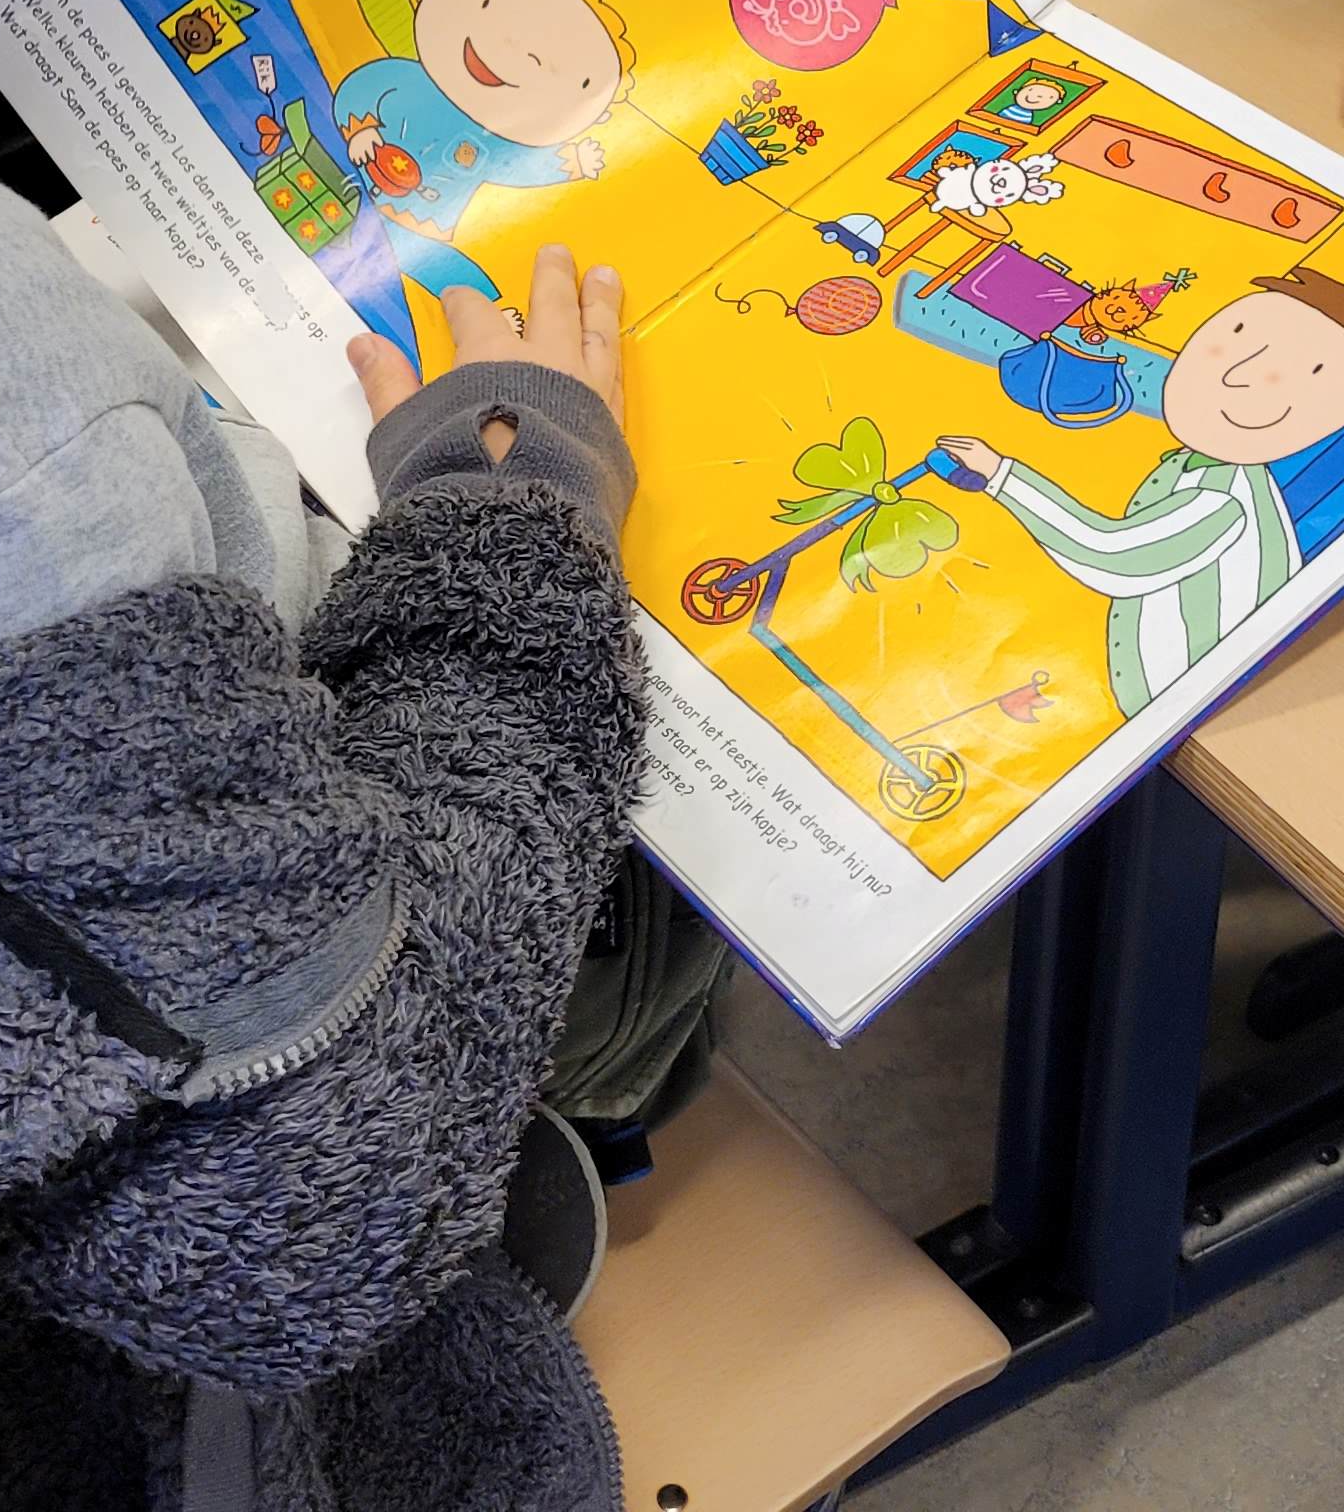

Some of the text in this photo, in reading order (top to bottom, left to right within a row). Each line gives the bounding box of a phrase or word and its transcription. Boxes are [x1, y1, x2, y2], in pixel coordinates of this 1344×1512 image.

[67, 8, 84, 28] de
[77, 26, 110, 61] poes
[106, 62, 125, 77] al
[114, 77, 177, 144] gevonden?
[0, 3, 205, 269] Wat draagt Sam de poes op haar kopje?
[55, 34, 97, 90] kleuren
[94, 86, 136, 142] hebben
[134, 141, 151, 161] de
[149, 160, 178, 196] twee
[175, 195, 222, 251] wieltjes
[219, 250, 240, 277] van
[238, 277, 256, 296] de
[171, 144, 195, 173] Los
[192, 174, 215, 201] dan
[211, 200, 241, 229] snel
[235, 230, 264, 264] deze
[307, 321, 328, 342] op:
[638, 748, 695, 797] rootste?
[660, 727, 697, 759] staat
[694, 758, 713, 772] er
[709, 773, 728, 791] op
[724, 788, 753, 815] zijn
[750, 808, 798, 852] kopje?
[671, 693, 701, 719] voor
[697, 715, 723, 742] het
[720, 738, 768, 790] feestje.
[770, 783, 802, 815] Wat
[799, 814, 846, 856] draagt
[841, 851, 869, 880] hij
[861, 873, 892, 897] nu?
